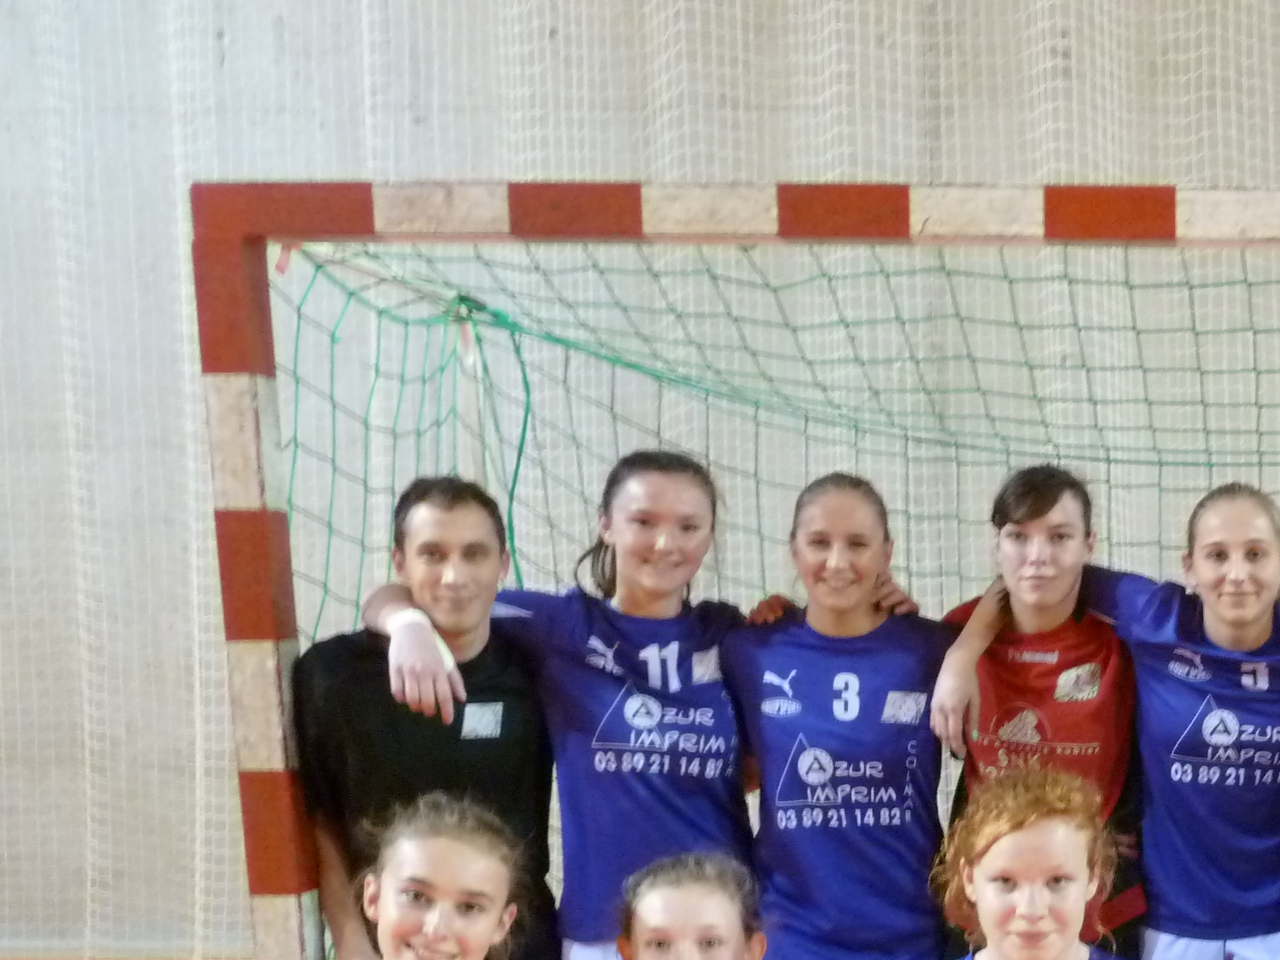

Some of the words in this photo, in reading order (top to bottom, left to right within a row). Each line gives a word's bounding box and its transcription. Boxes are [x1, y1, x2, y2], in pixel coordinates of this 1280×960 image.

[638, 640, 682, 693] 11
[832, 672, 860, 722] 3
[630, 729, 726, 754] IMPRIM
[594, 751, 617, 772] 03
[621, 752, 645, 773] 89
[649, 753, 670, 774] 21
[679, 756, 701, 777] 14
[1170, 762, 1193, 783] 03
[1197, 765, 1221, 784] 89
[1224, 767, 1245, 786] 21
[1254, 768, 1274, 786] 14
[806, 784, 897, 803] IMPRIM
[777, 808, 798, 830] 03
[802, 807, 823, 828] 89
[828, 808, 847, 828] 21
[855, 808, 875, 827] 14
[880, 807, 901, 826] 82
